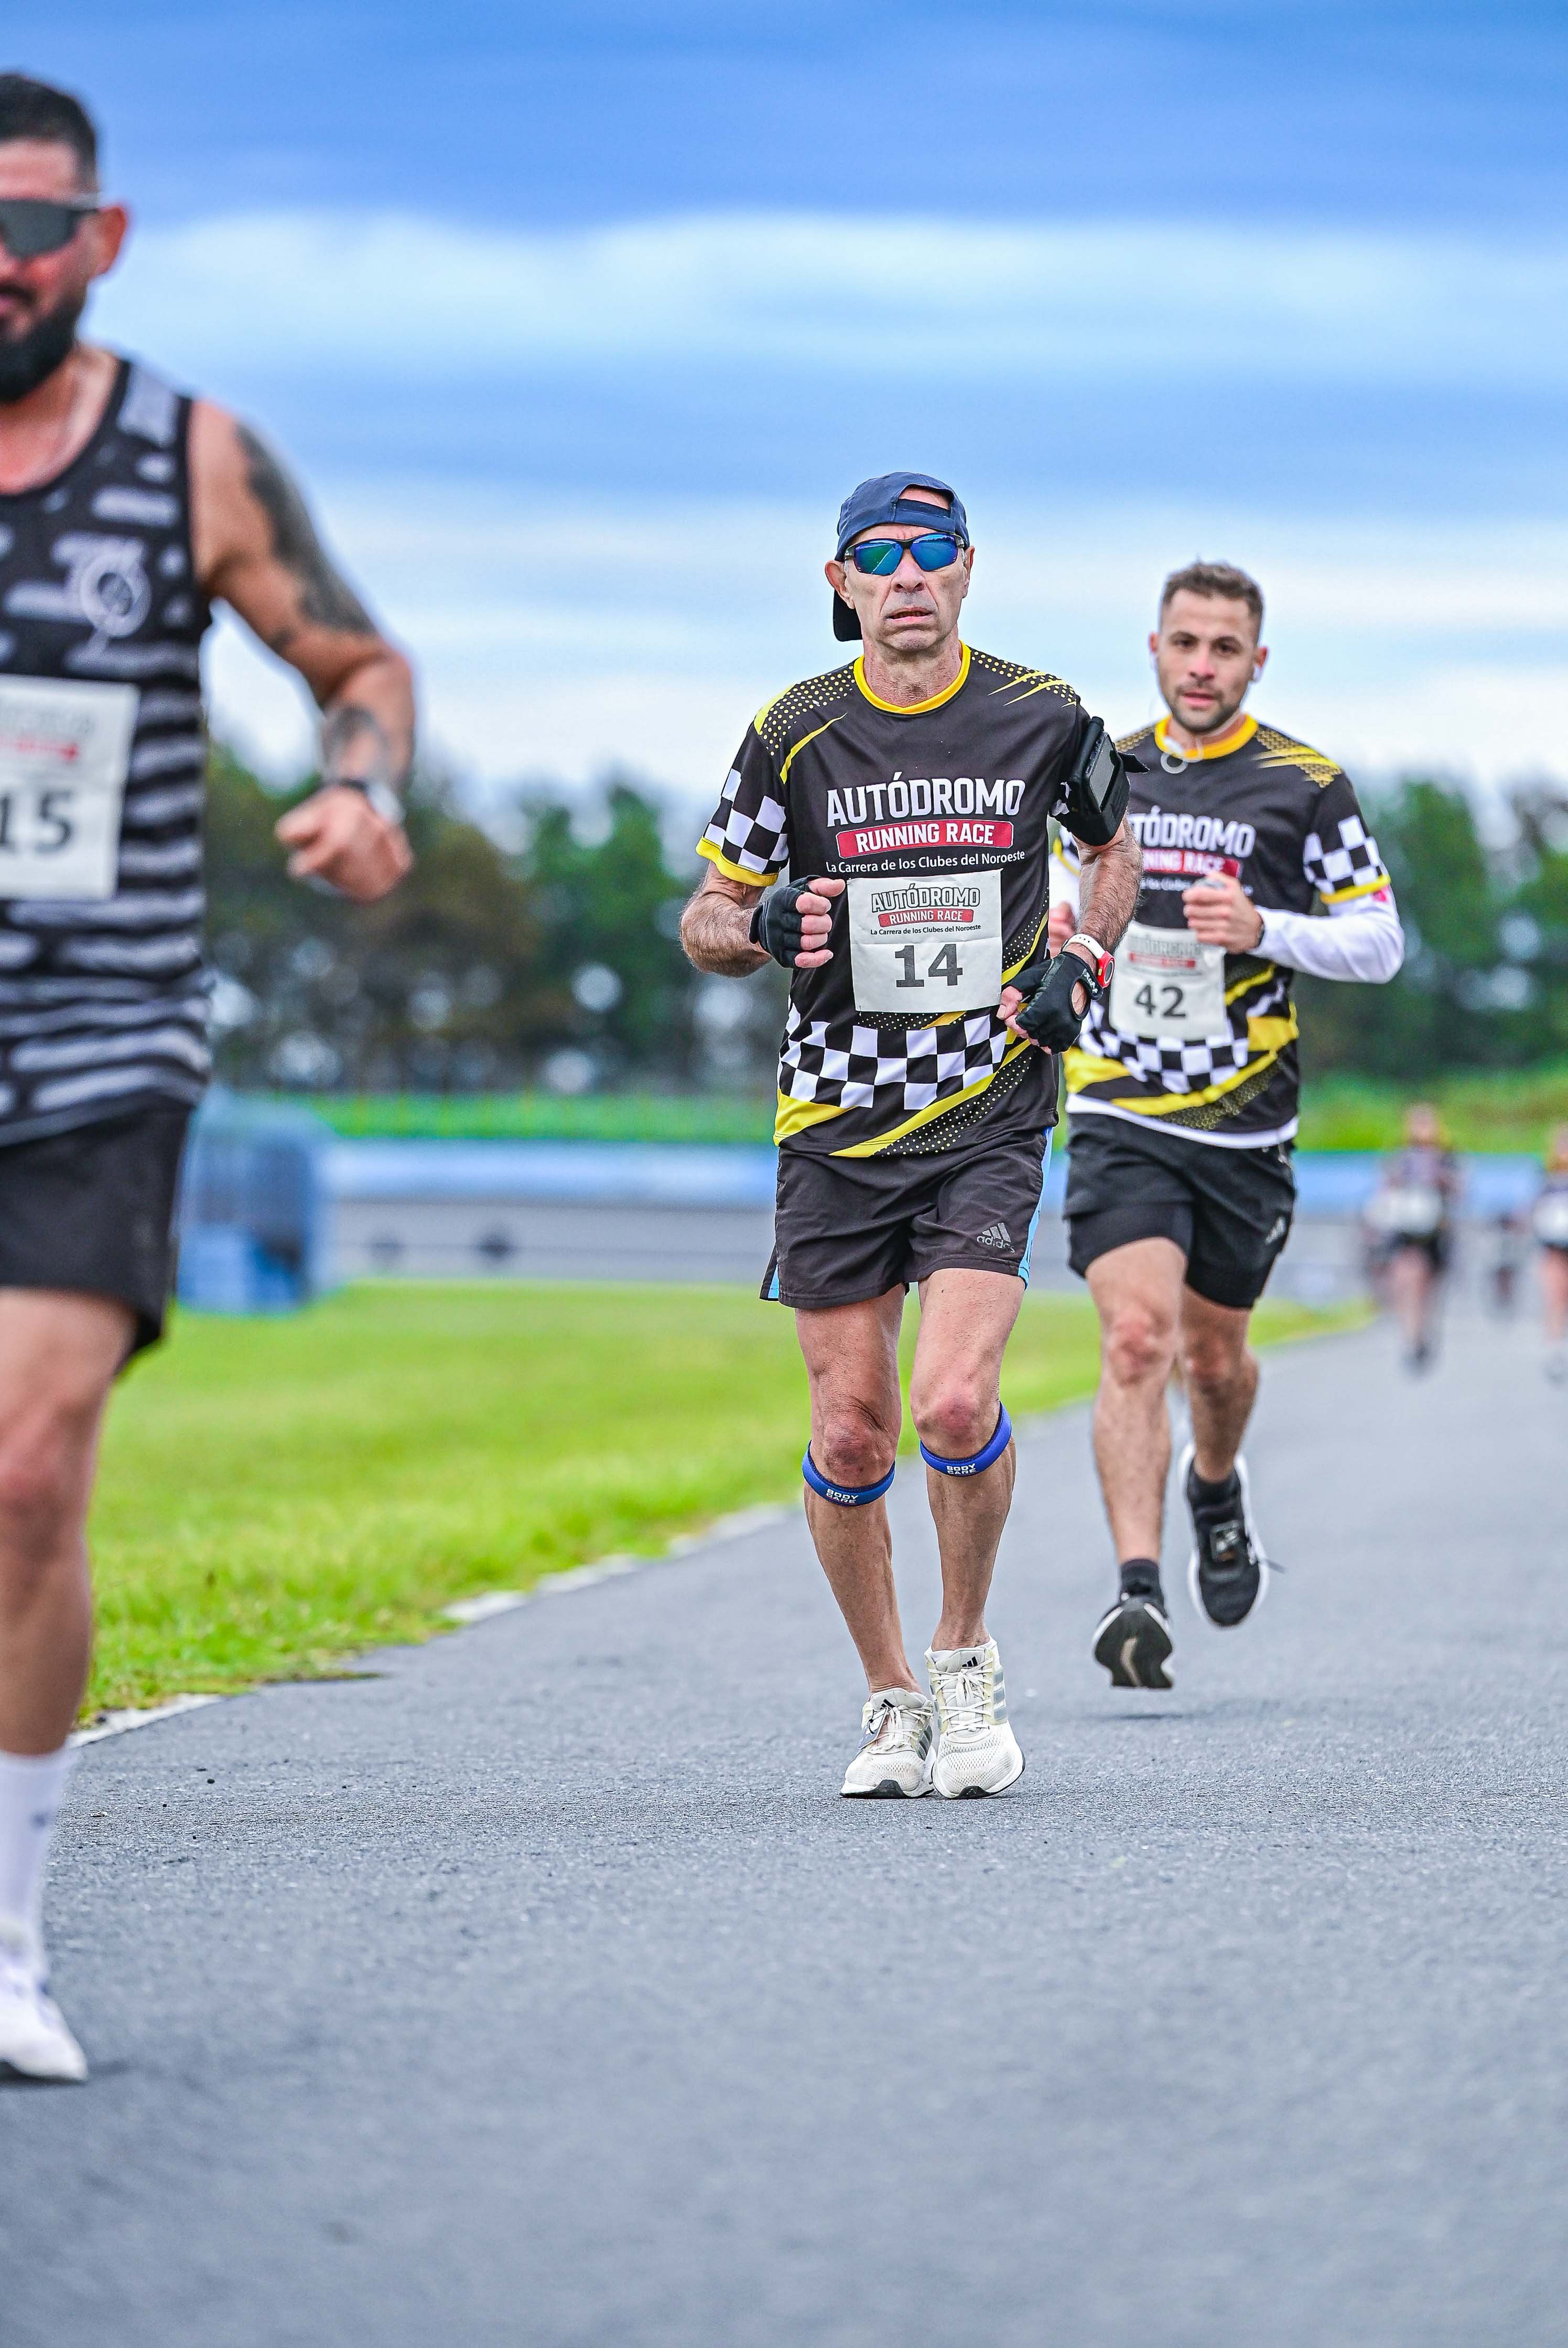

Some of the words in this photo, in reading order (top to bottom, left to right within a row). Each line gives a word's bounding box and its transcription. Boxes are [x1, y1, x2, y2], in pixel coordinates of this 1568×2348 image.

[827, 772, 1026, 827] AUTÓDROMO
[855, 823, 940, 854] RUNNING
[946, 823, 995, 845] RACE
[1128, 805, 1257, 858] TÓDROMO
[826, 861, 837, 873] La
[839, 861, 878, 873] Carrera
[881, 859, 896, 871] de
[899, 858, 916, 869] los
[918, 855, 958, 868] Clubes
[960, 854, 978, 866] del
[981, 850, 1025, 865] Noroeste
[871, 883, 980, 913] AUTÓDROMO
[889, 910, 934, 925] RUNNING
[937, 910, 964, 921] RACE
[895, 944, 963, 987] 14
[1135, 984, 1186, 1017] 42
[826, 1492, 856, 1503] CARE
[827, 1488, 859, 1500] BODY
